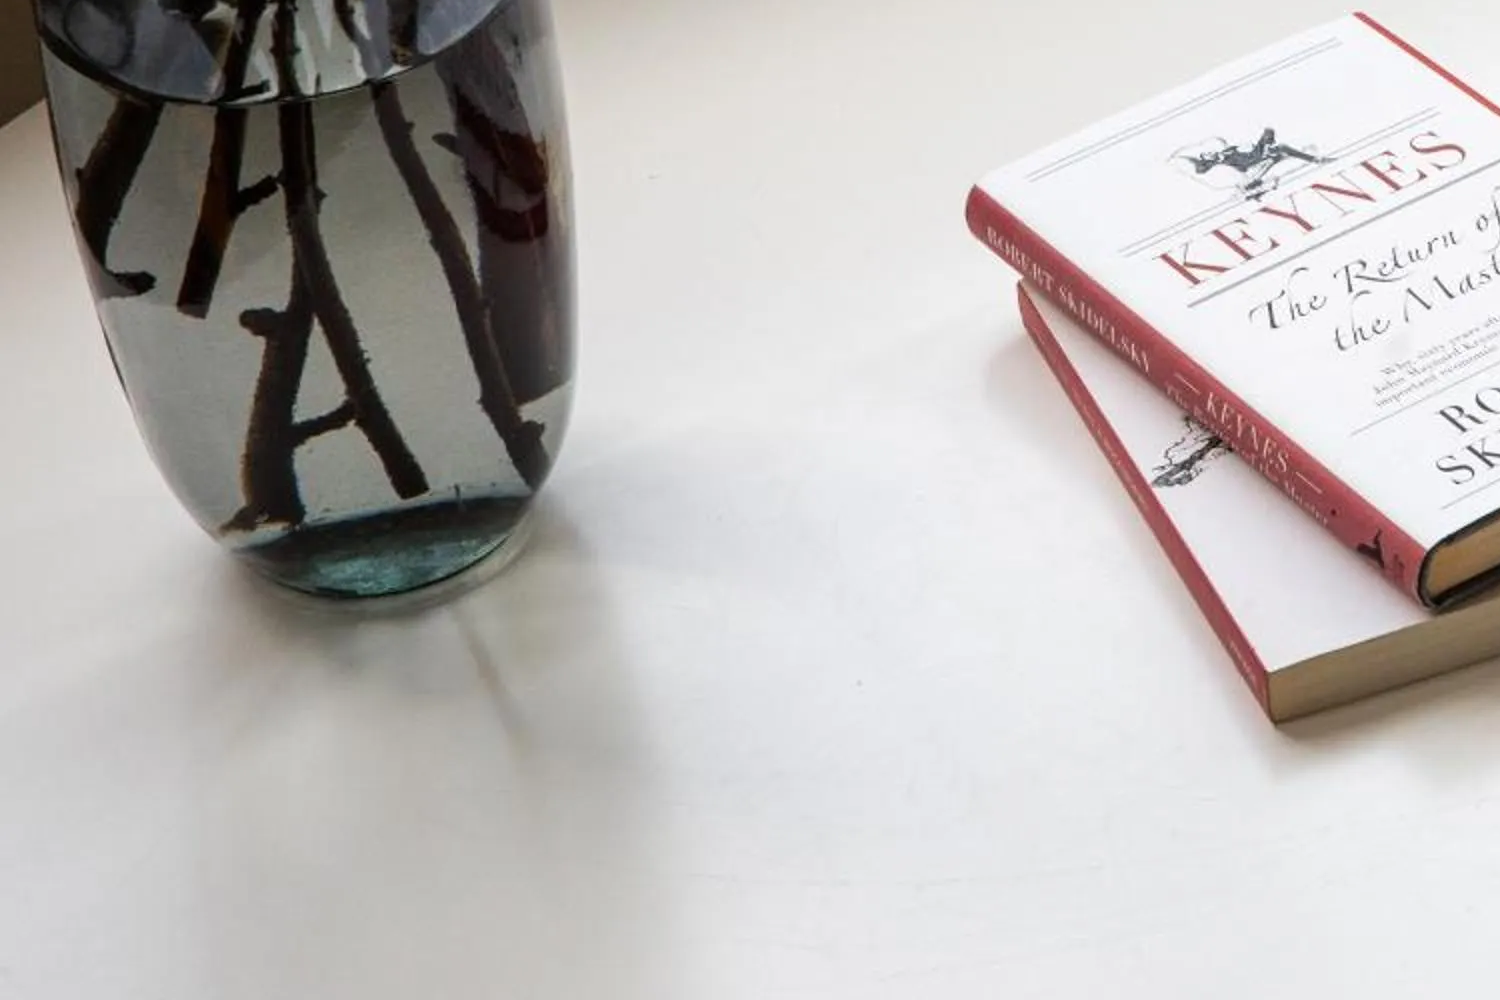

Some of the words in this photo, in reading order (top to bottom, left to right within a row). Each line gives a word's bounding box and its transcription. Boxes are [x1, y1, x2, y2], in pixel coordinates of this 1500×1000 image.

[1152, 131, 1467, 287] KEYNES
[985, 225, 1054, 292] ROBERT
[1058, 283, 1150, 374] SKIDELSKY
[1249, 266, 1327, 329] The
[1332, 229, 1458, 294] Return
[1333, 290, 1391, 352] the
[1206, 391, 1289, 474] KEYNES
